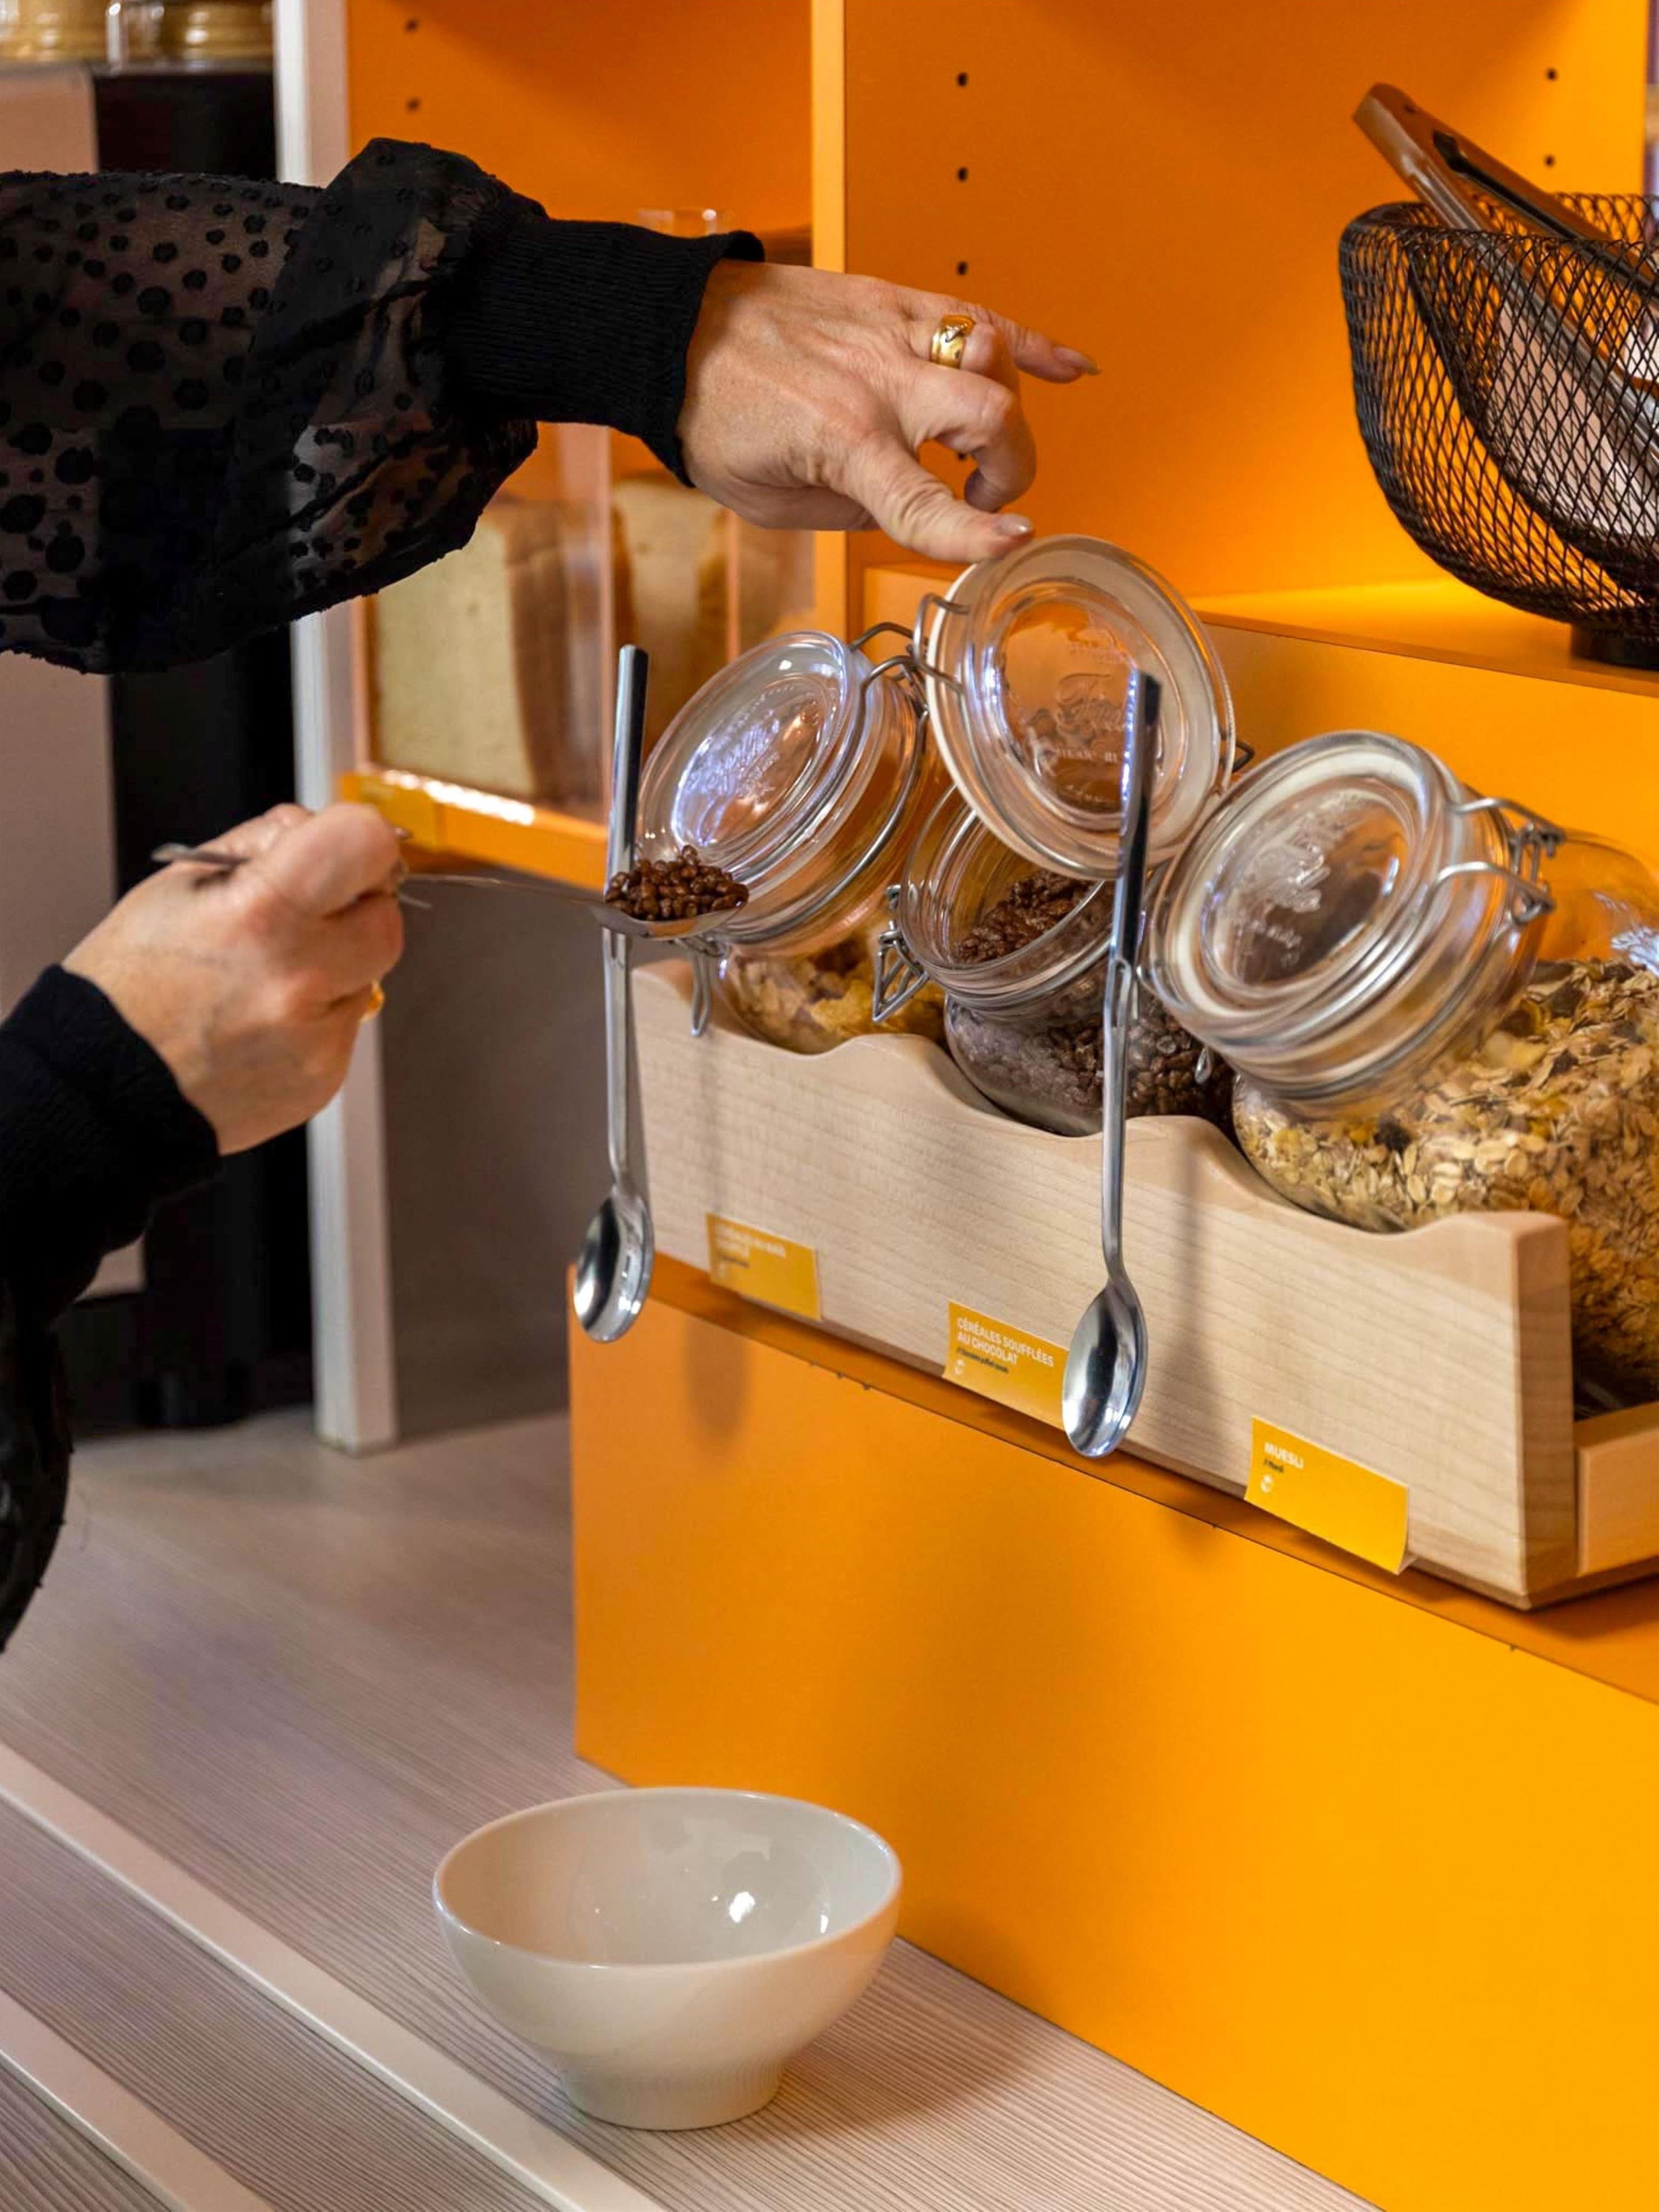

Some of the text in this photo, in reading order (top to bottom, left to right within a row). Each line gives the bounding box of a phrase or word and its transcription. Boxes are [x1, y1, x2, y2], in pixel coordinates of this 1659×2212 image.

[957, 1316, 1002, 1344] CÉRÉALES
[1003, 1336, 1054, 1367] SOUFFLÉES
[957, 1332, 970, 1346] AU
[972, 1337, 1019, 1365] CHOCOLAT
[1263, 1441, 1304, 1469] MUESLI
